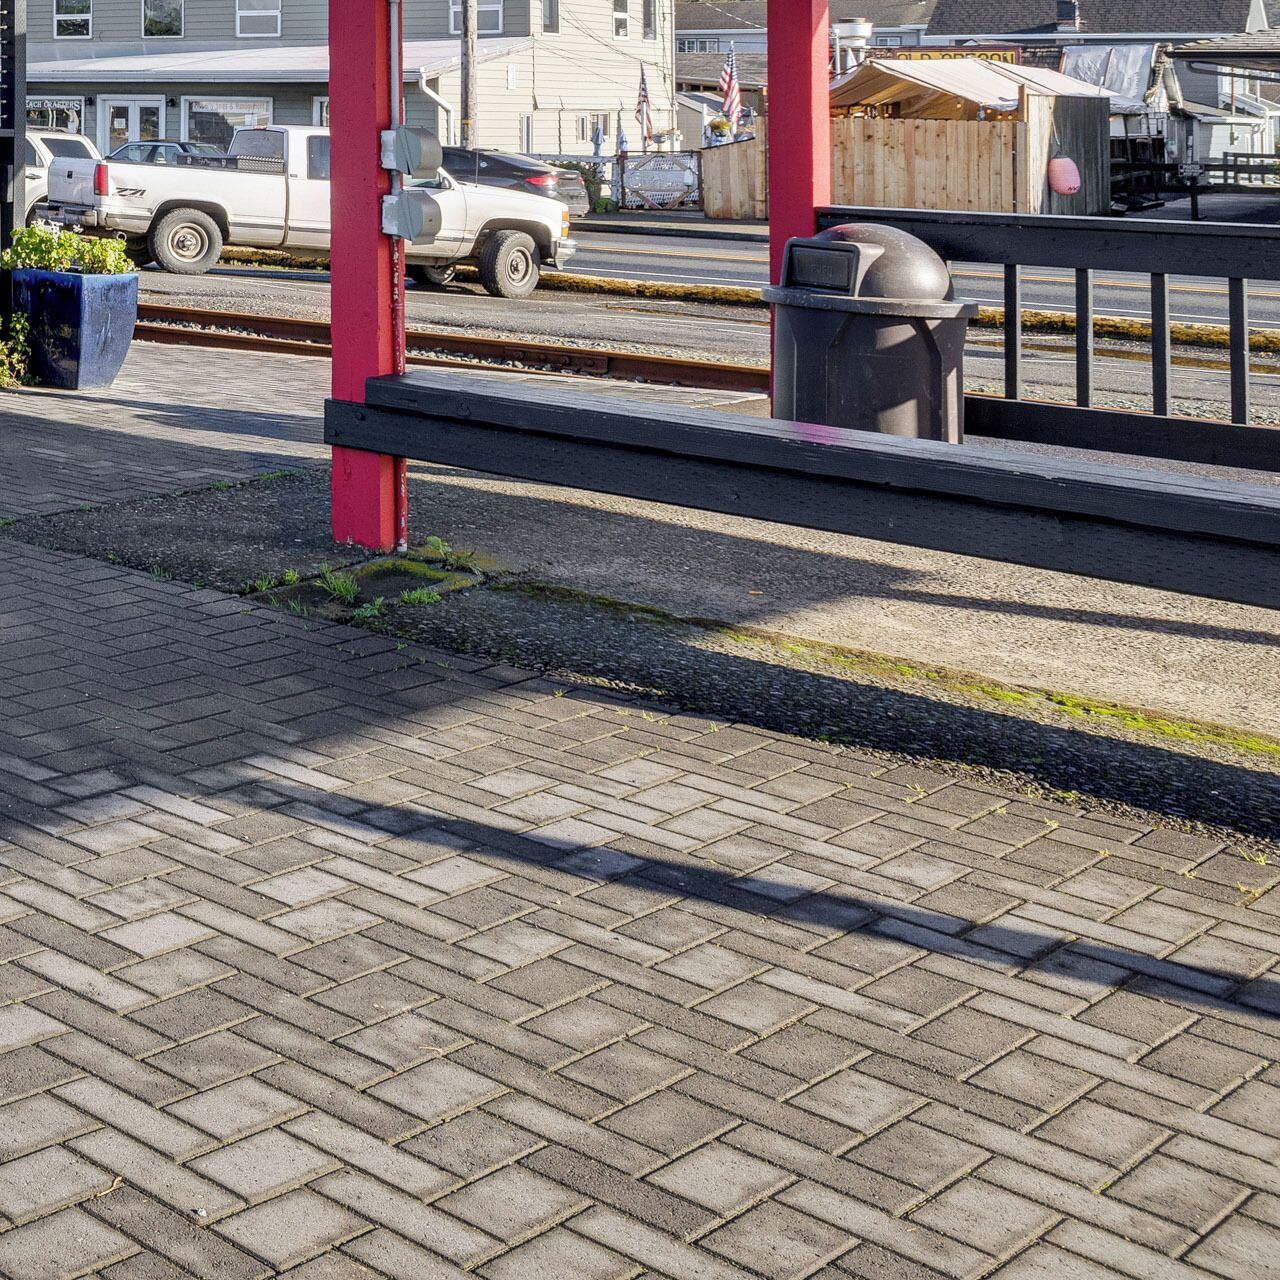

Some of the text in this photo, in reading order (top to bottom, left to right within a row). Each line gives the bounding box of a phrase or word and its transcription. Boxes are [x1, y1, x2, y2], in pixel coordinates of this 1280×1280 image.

[941, 53, 1014, 65] ORGON
[26, 101, 42, 109] EACH
[115, 187, 146, 197] Z71
